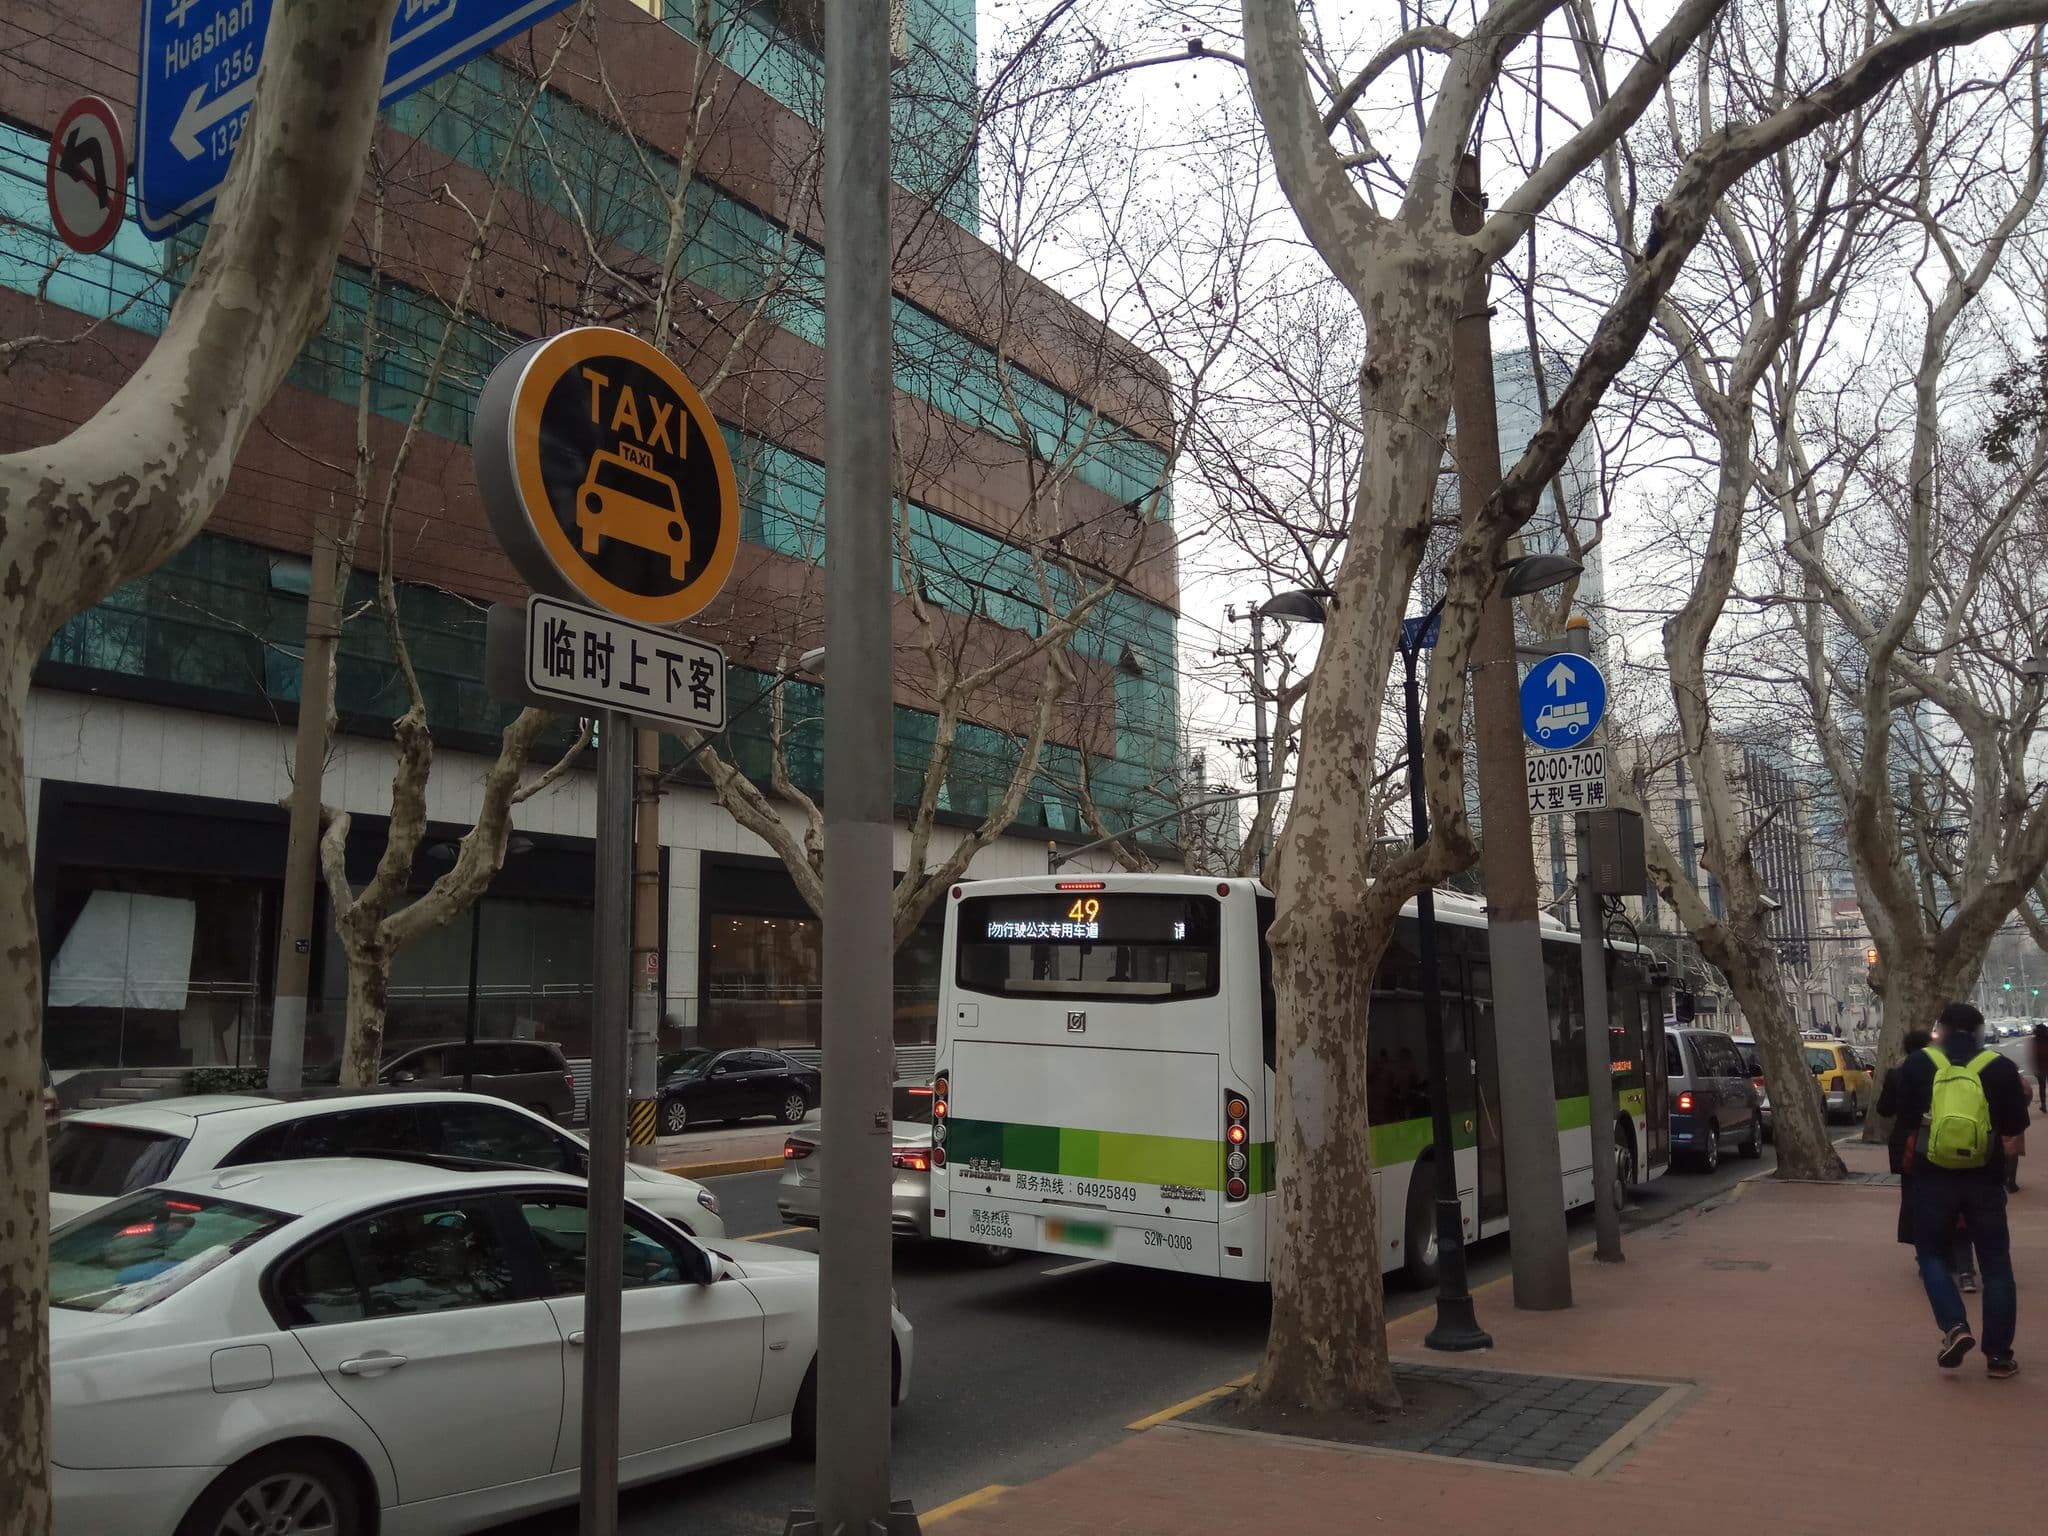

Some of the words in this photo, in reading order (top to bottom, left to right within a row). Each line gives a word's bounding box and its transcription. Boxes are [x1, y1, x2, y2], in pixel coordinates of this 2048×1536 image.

[164, 0, 253, 80] Huashan
[213, 41, 254, 93] 1356
[582, 366, 688, 461] TAXI
[621, 445, 651, 469] TAXI
[543, 616, 716, 713] 临时上下客
[1529, 780, 1604, 812] 大型号牌
[987, 921, 1099, 939] 勿行驶公交专用车道
[1068, 898, 1100, 923] 49
